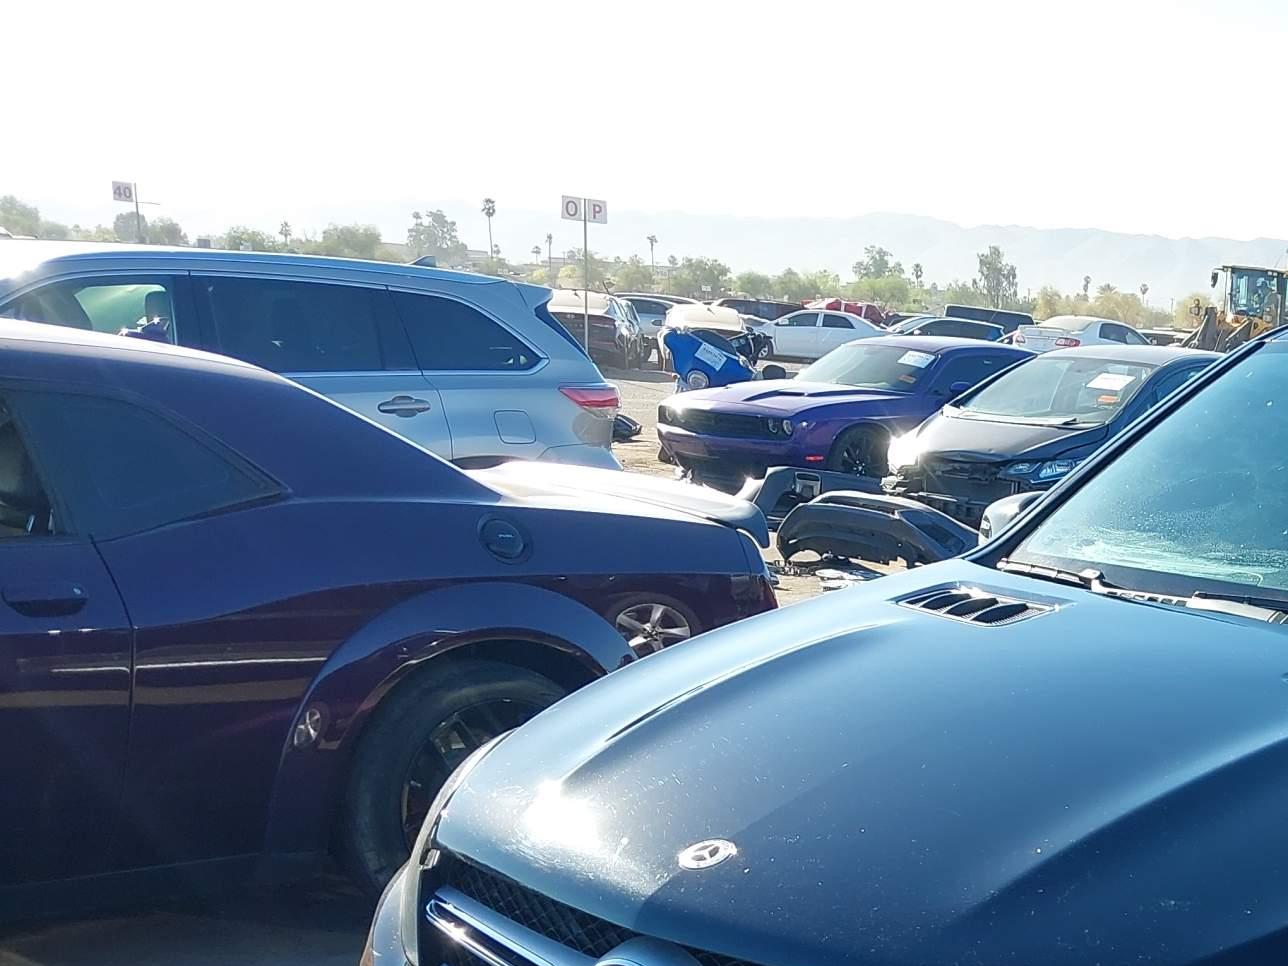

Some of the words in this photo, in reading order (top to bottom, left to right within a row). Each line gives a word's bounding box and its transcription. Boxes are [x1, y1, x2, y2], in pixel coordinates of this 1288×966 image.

[112, 185, 132, 199] 40
[565, 200, 578, 217] O
[592, 203, 602, 220] P
